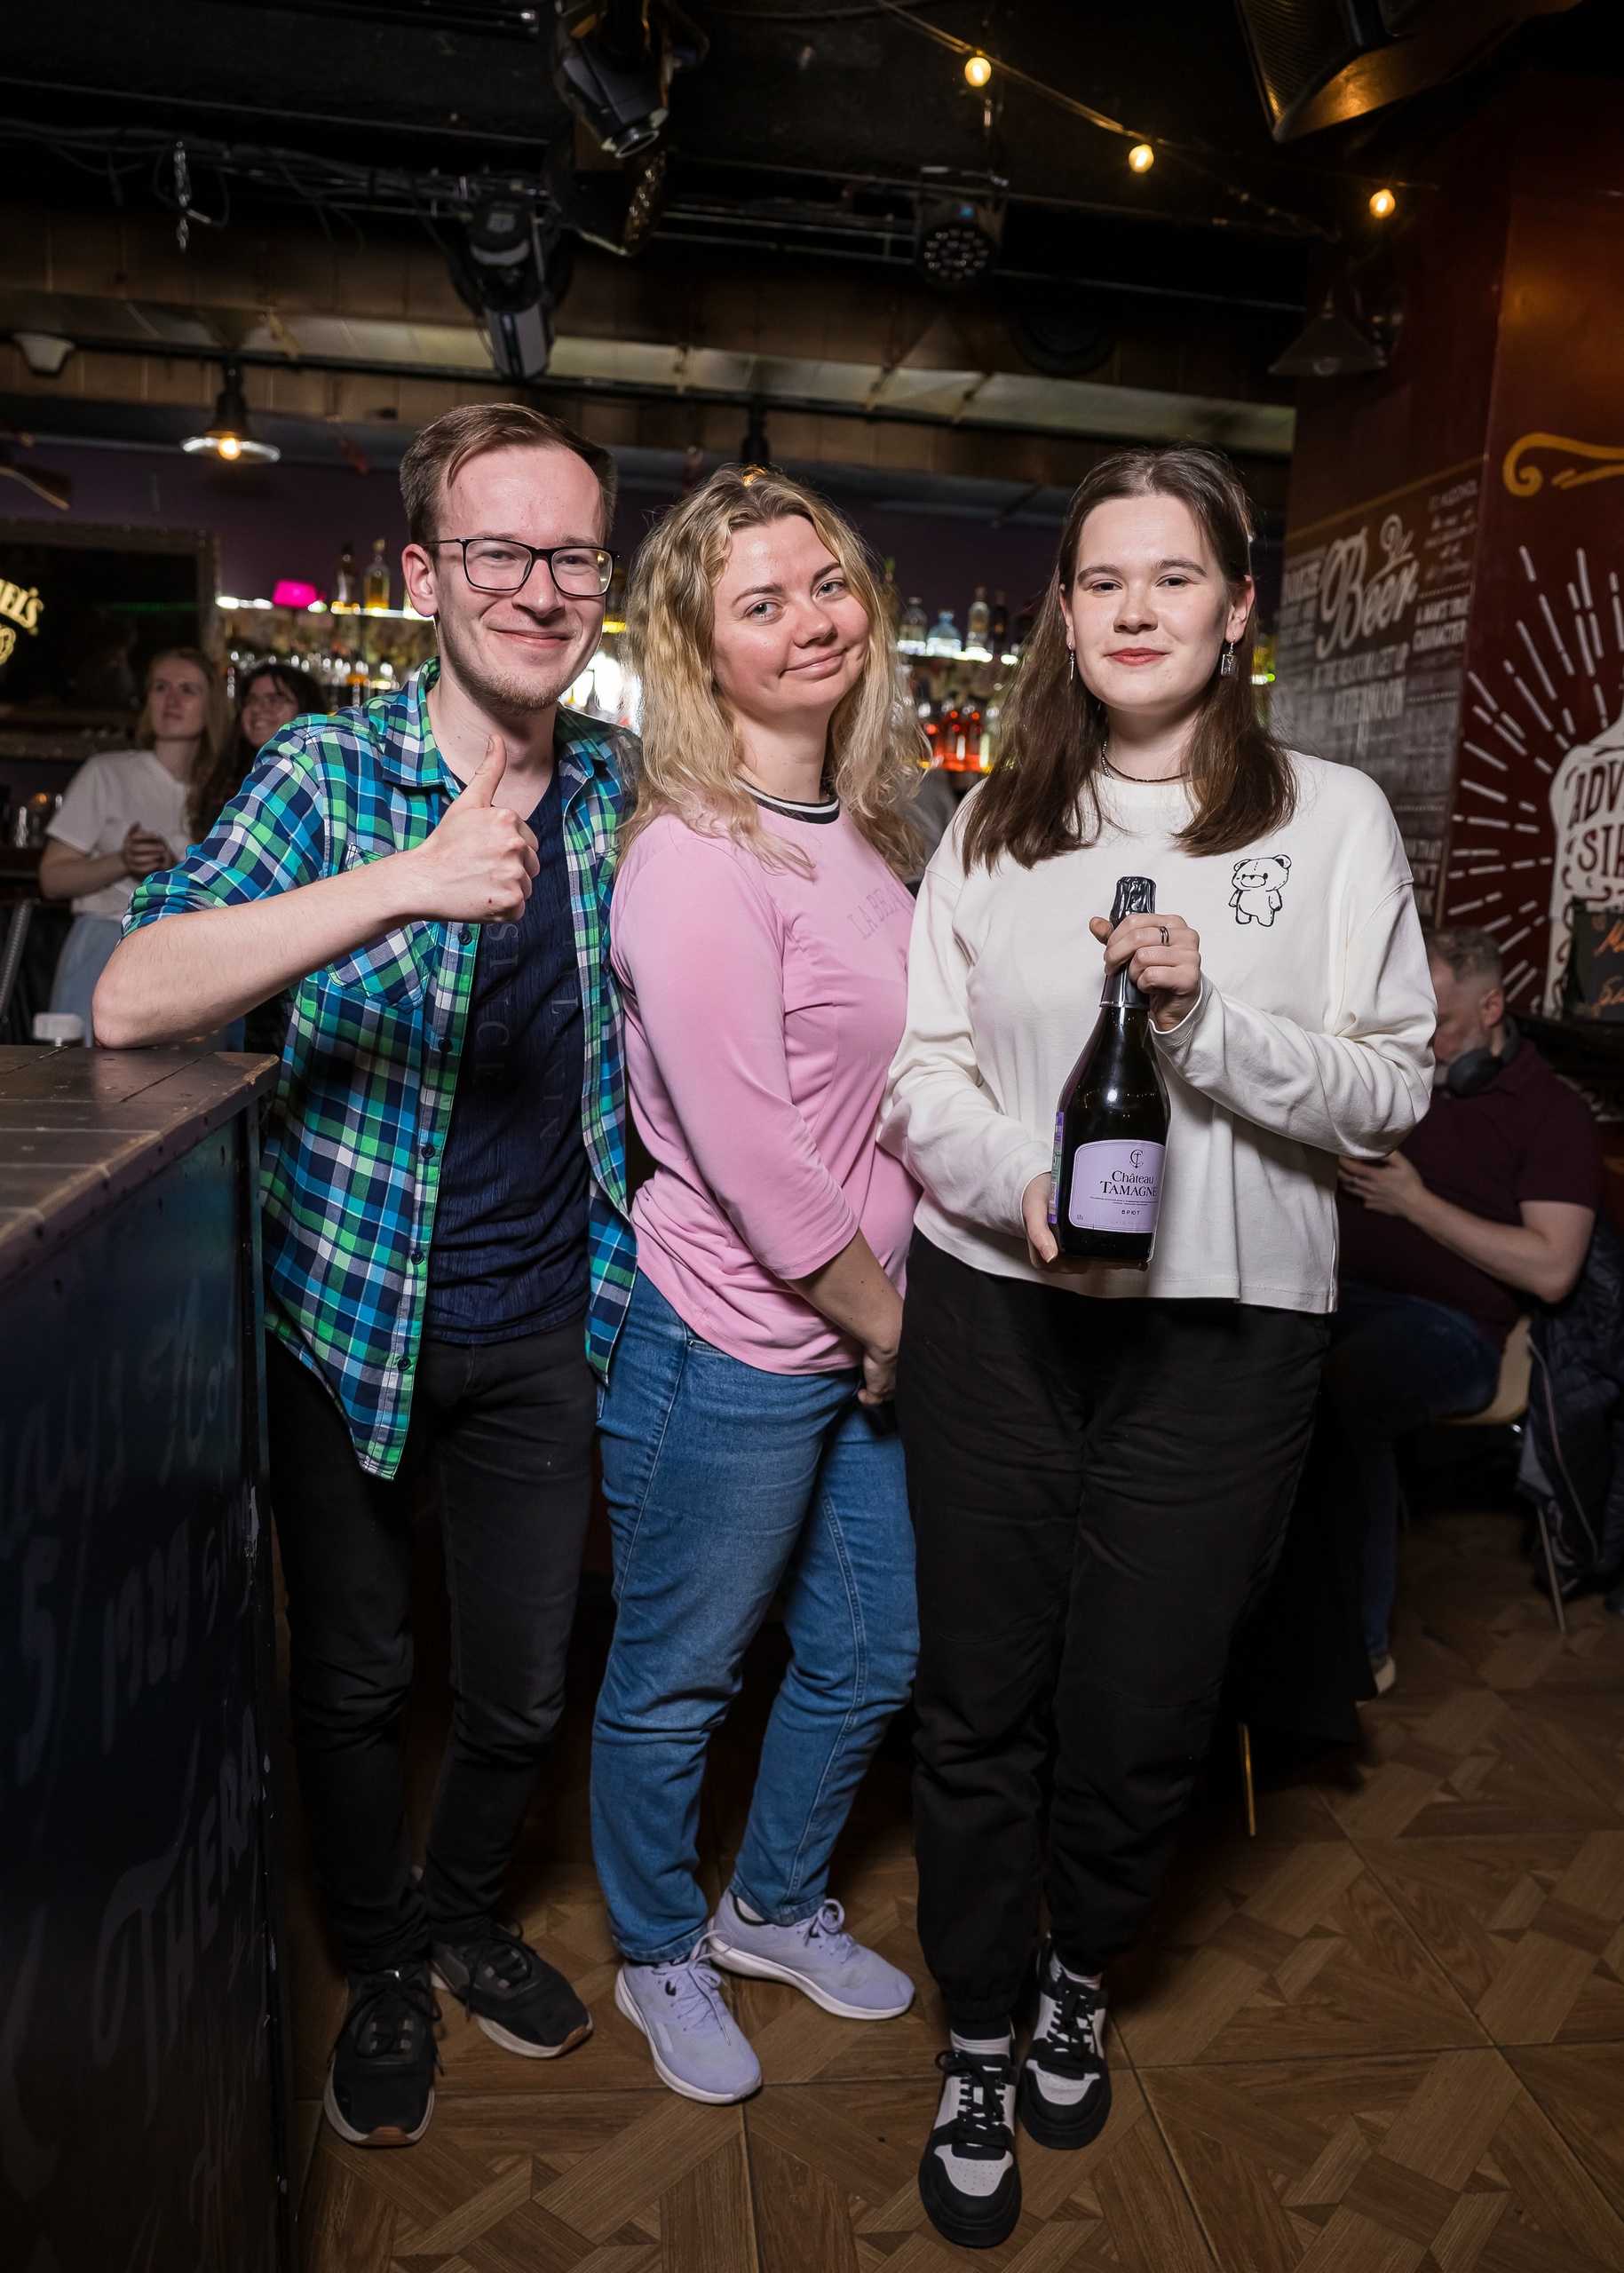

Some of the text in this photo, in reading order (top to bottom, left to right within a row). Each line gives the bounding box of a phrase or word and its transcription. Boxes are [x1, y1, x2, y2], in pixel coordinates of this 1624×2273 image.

[1316, 527, 1420, 660] Beer
[846, 906, 877, 939] LA
[472, 923, 519, 1084] SINCE
[1099, 1180, 1158, 1197] TAMAGNE
[1112, 1170, 1154, 1184] Château
